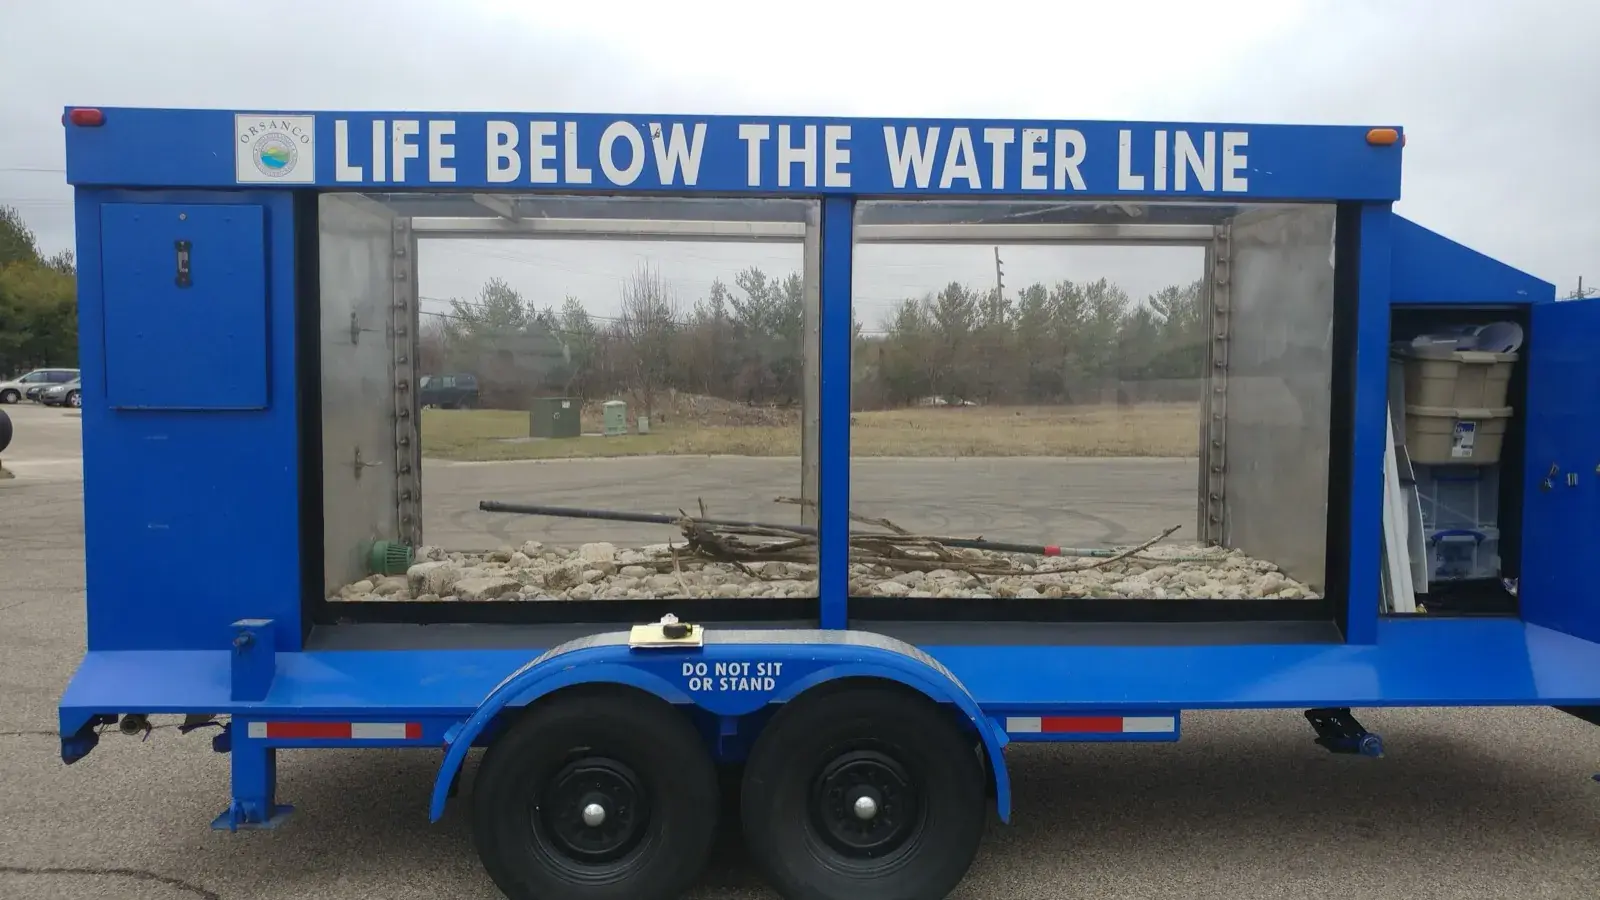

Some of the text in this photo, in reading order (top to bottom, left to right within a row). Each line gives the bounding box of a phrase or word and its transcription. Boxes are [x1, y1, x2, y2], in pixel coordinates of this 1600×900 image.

[240, 120, 310, 144] ORSANCO
[335, 120, 456, 182] LIFE
[486, 120, 708, 186] BELOW
[738, 124, 852, 188] THE
[883, 126, 1087, 190] WATER
[1118, 129, 1249, 192] LINE
[682, 662, 783, 676] DO NOT SIT
[688, 677, 776, 691] OR STAND
